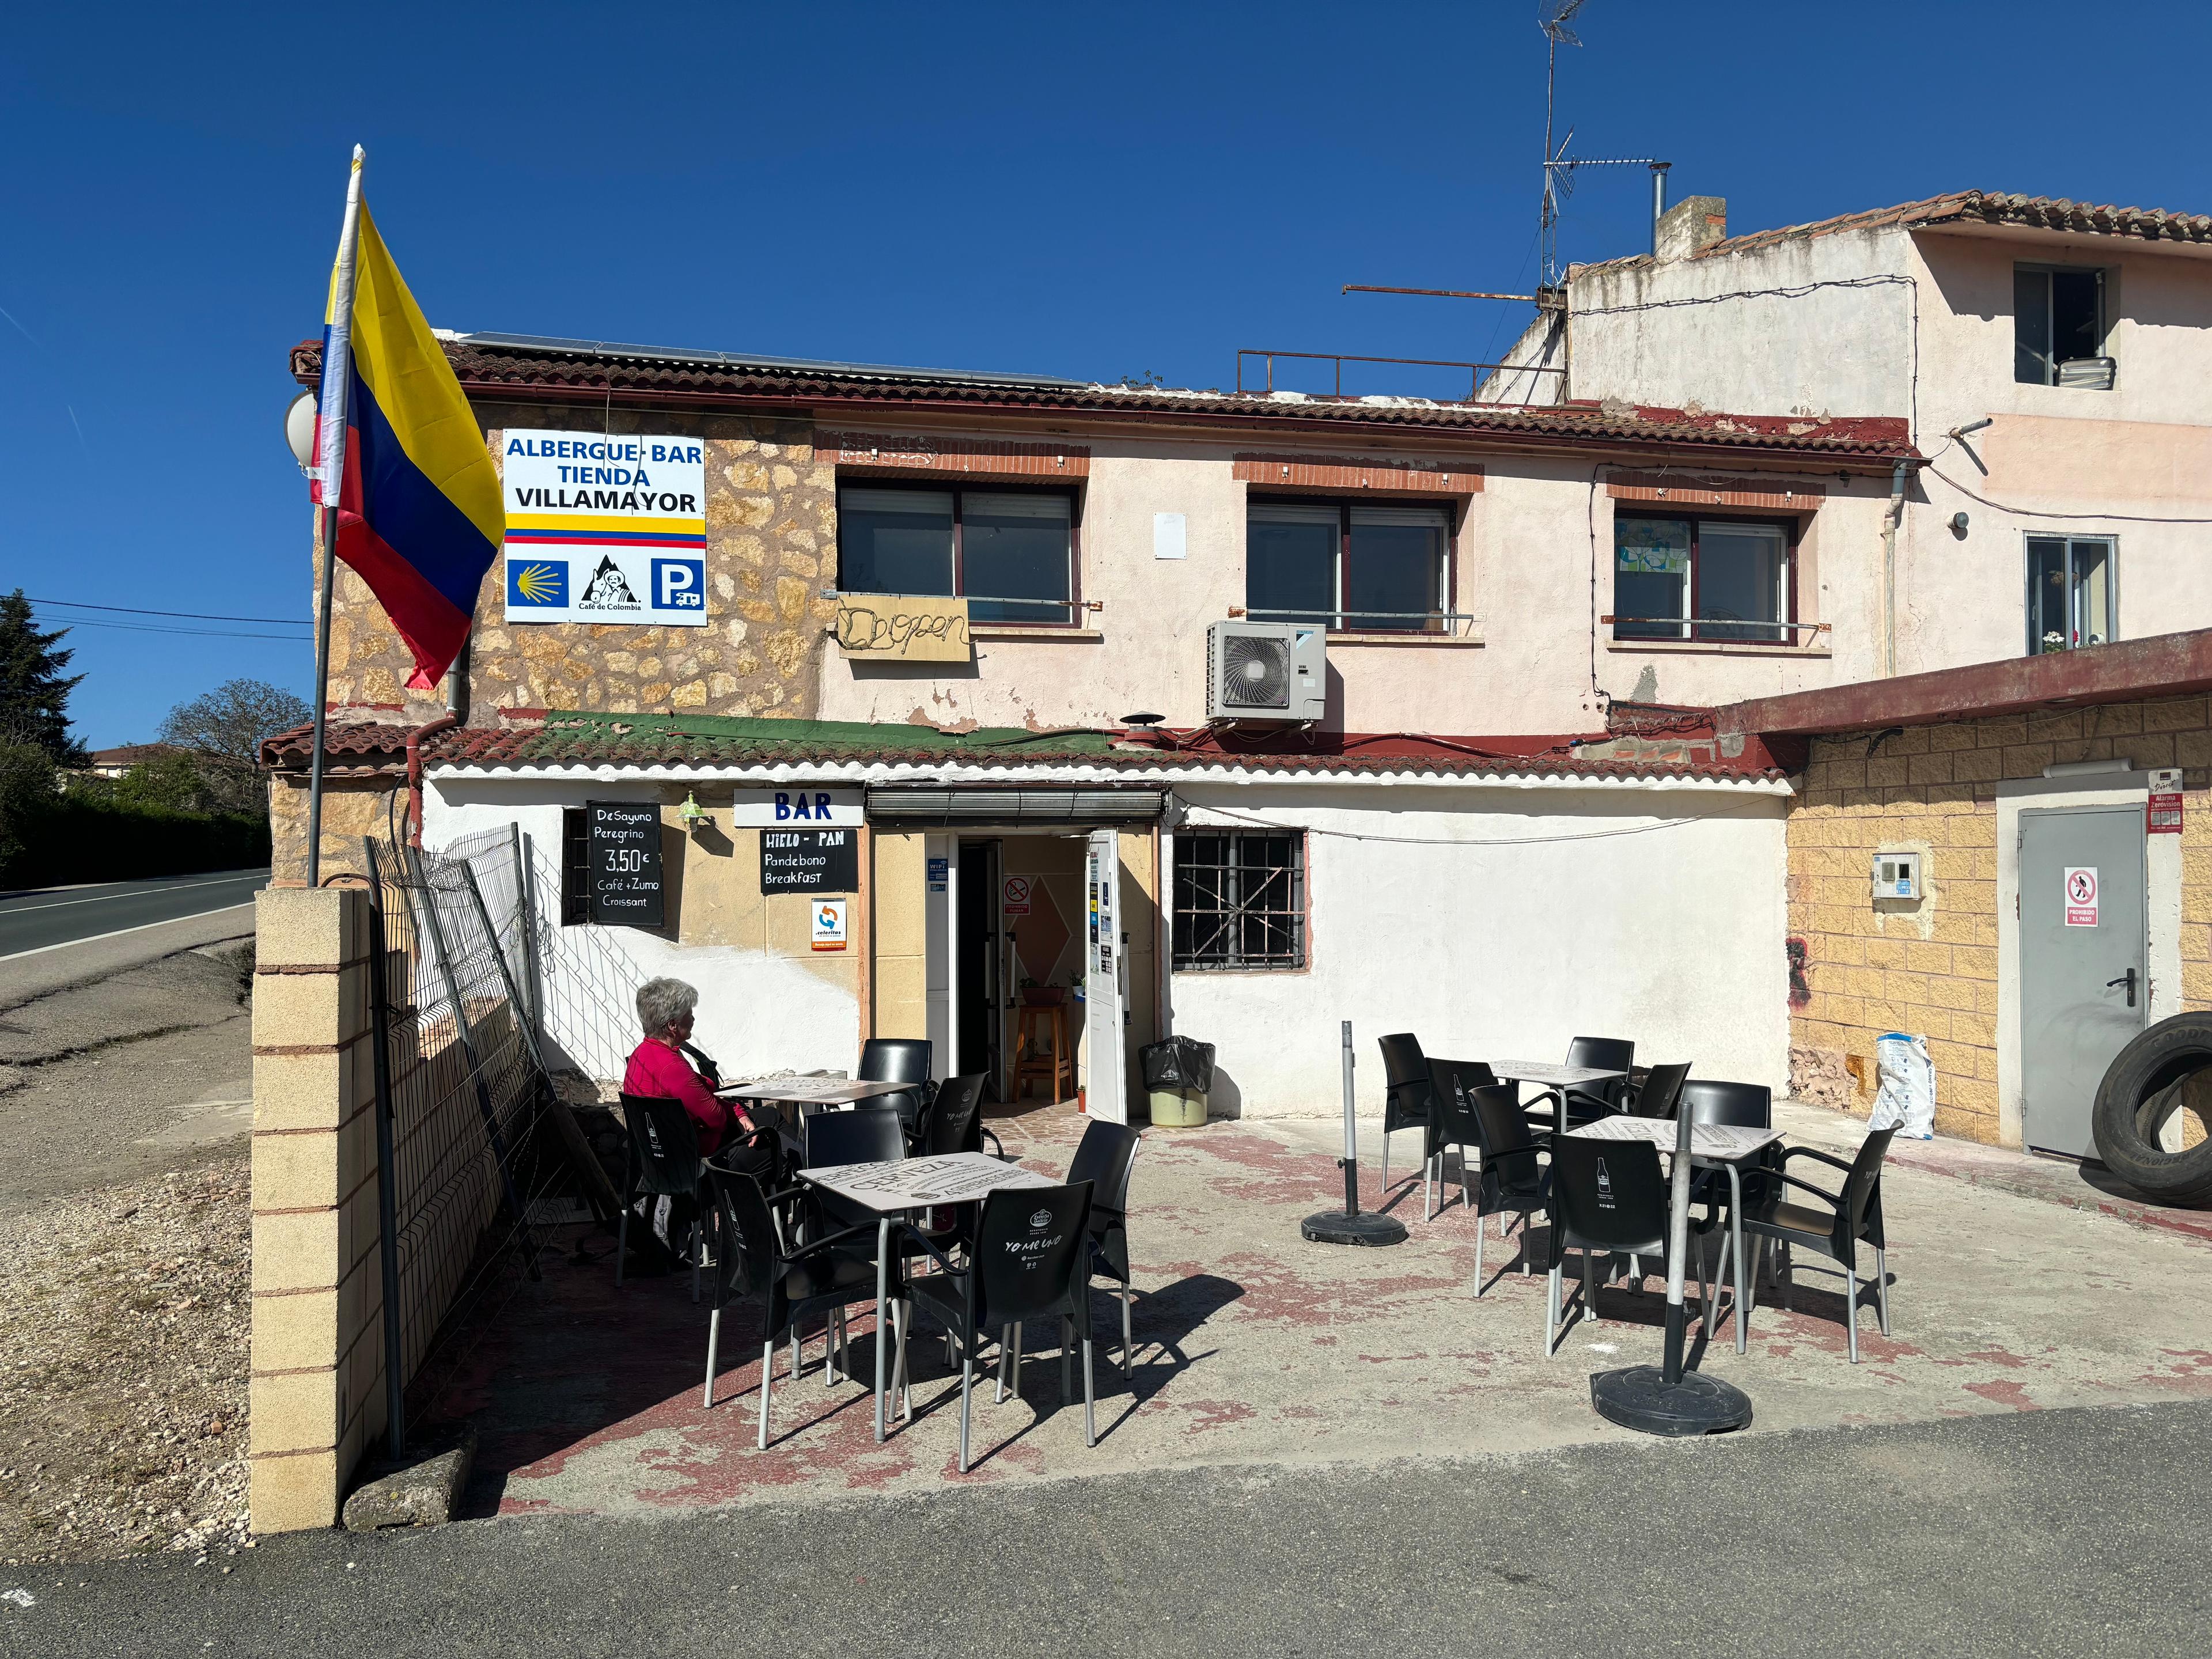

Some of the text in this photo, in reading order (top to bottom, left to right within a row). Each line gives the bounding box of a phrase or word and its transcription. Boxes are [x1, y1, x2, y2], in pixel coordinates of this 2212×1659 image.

[507, 438, 638, 461] ALBERGUE
[652, 445, 702, 464] BAR
[558, 465, 650, 486] TIENDA
[516, 488, 696, 513] VILLAMAYOR
[661, 564, 693, 604] P
[775, 792, 832, 820] BAR
[594, 827, 644, 843] Peregrino
[819, 831, 844, 846] PAN
[765, 854, 826, 866] Pandebono
[598, 878, 623, 890] Café
[603, 895, 647, 907] Croissant
[850, 1160, 964, 1190] CERVEZA
[1005, 1241, 1022, 1252] YO
